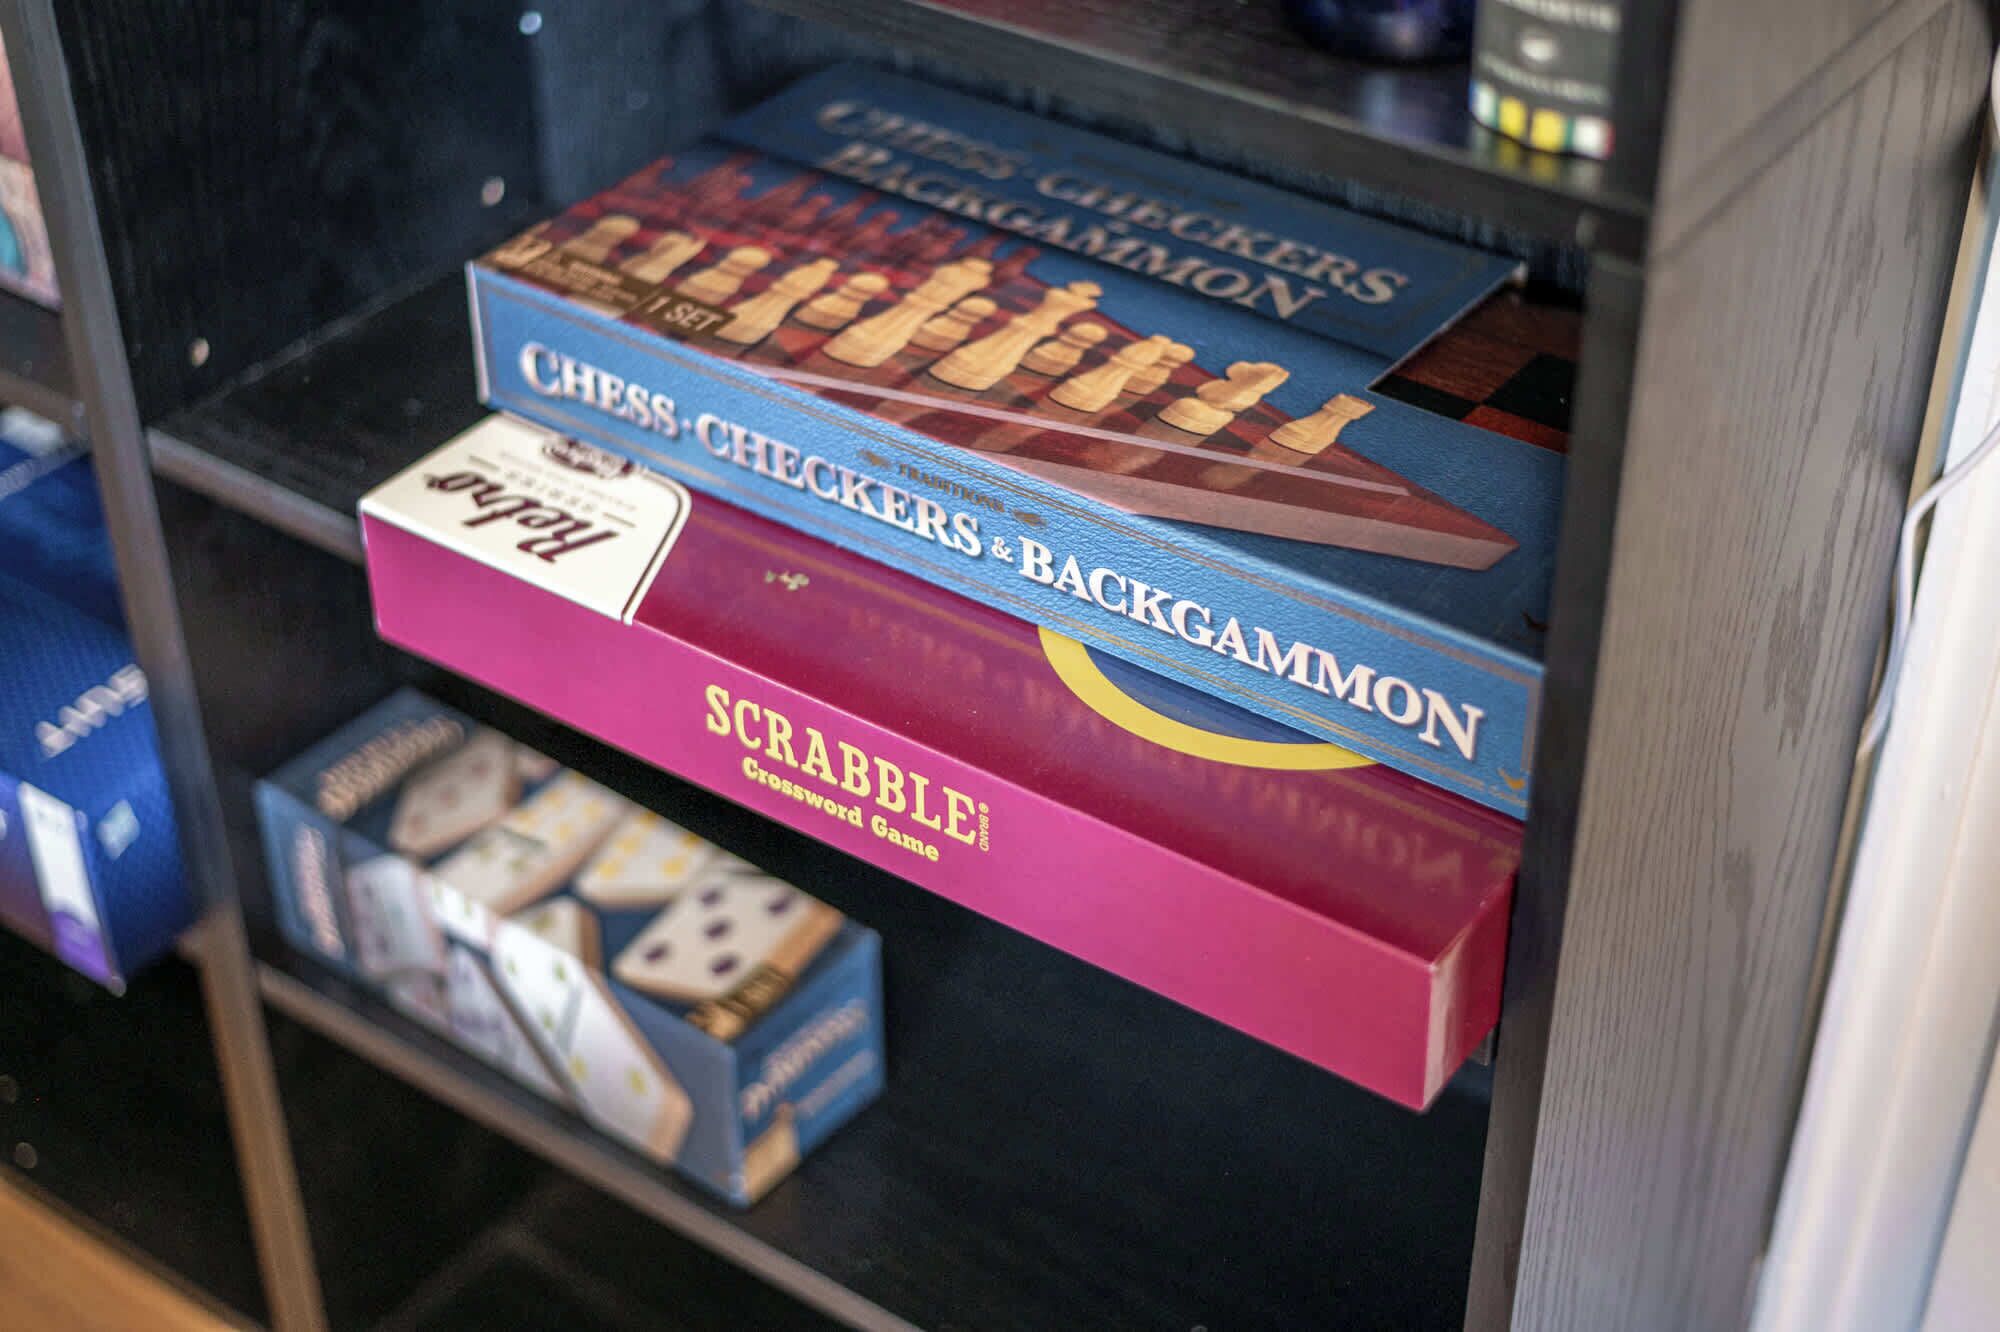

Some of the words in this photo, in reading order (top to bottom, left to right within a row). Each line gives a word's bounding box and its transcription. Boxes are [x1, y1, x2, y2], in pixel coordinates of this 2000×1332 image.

[821, 143, 1328, 319] BACKGAMMON
[1038, 173, 1408, 304] CHECKERS
[664, 303, 724, 331] SET
[425, 471, 620, 564] Retro
[899, 463, 1005, 514] TRADITIONS
[518, 342, 682, 440] CHESS
[697, 413, 983, 558] CHECKERS
[991, 535, 1014, 562] &
[1018, 535, 1486, 761] BACKGAMMON
[705, 684, 977, 846] SCRABBLE
[742, 756, 864, 829] Crossword
[871, 814, 940, 863] Game
[979, 814, 990, 852] BRAND
